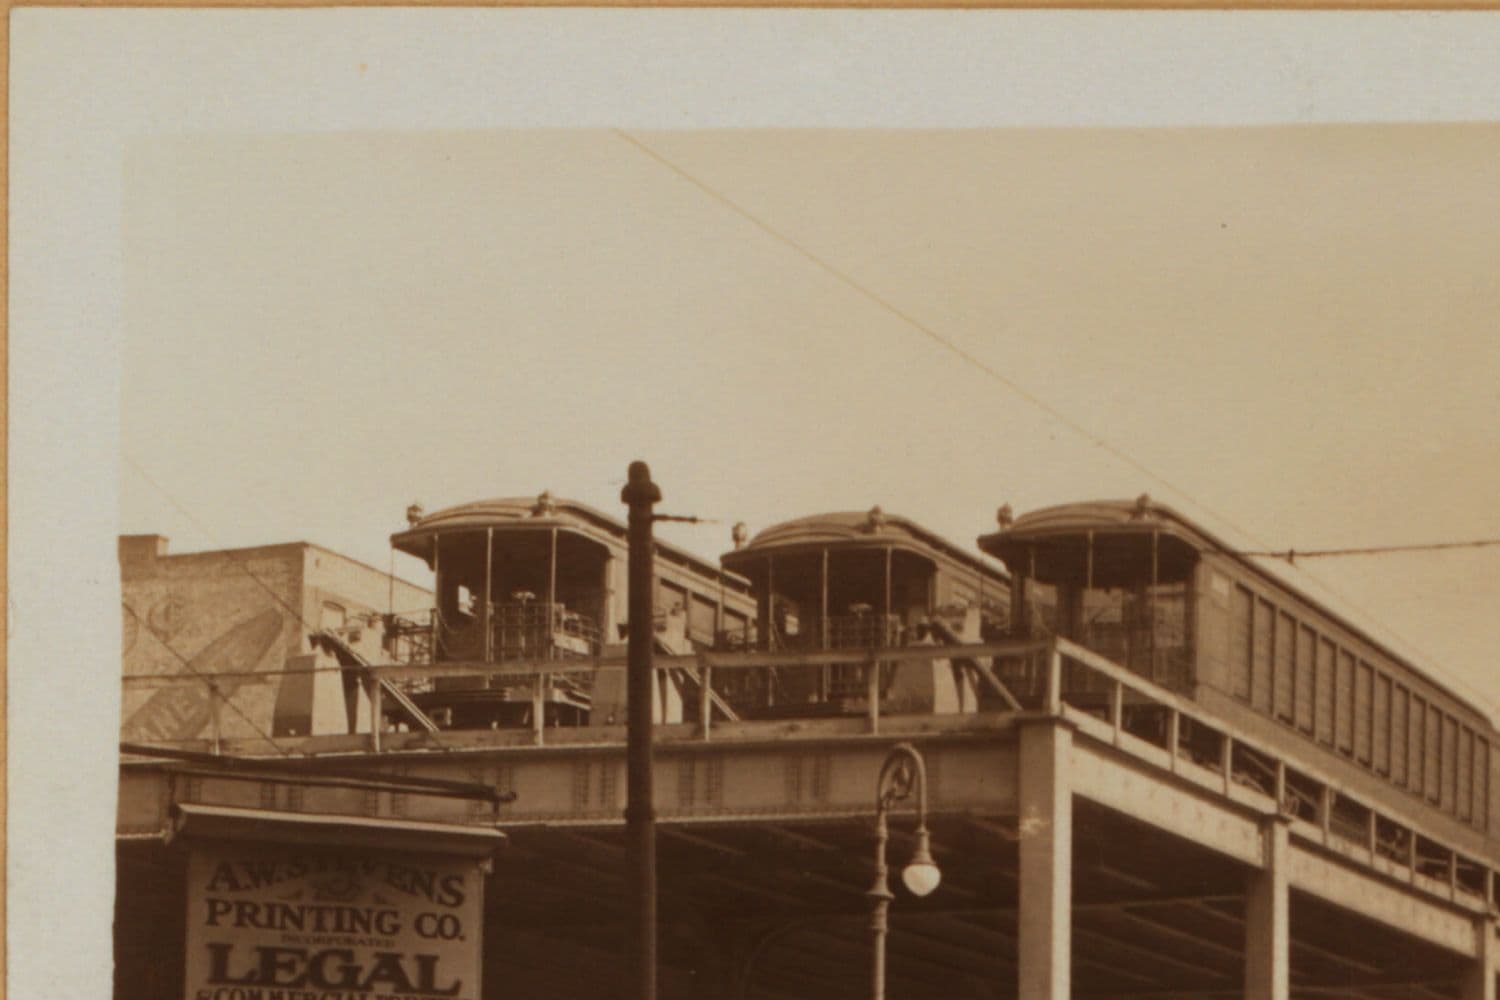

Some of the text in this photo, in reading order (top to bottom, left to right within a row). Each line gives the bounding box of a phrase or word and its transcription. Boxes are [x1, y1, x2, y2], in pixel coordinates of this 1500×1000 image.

[204, 898, 466, 942] PRINTING CO.
[204, 942, 463, 997] LEGAL
